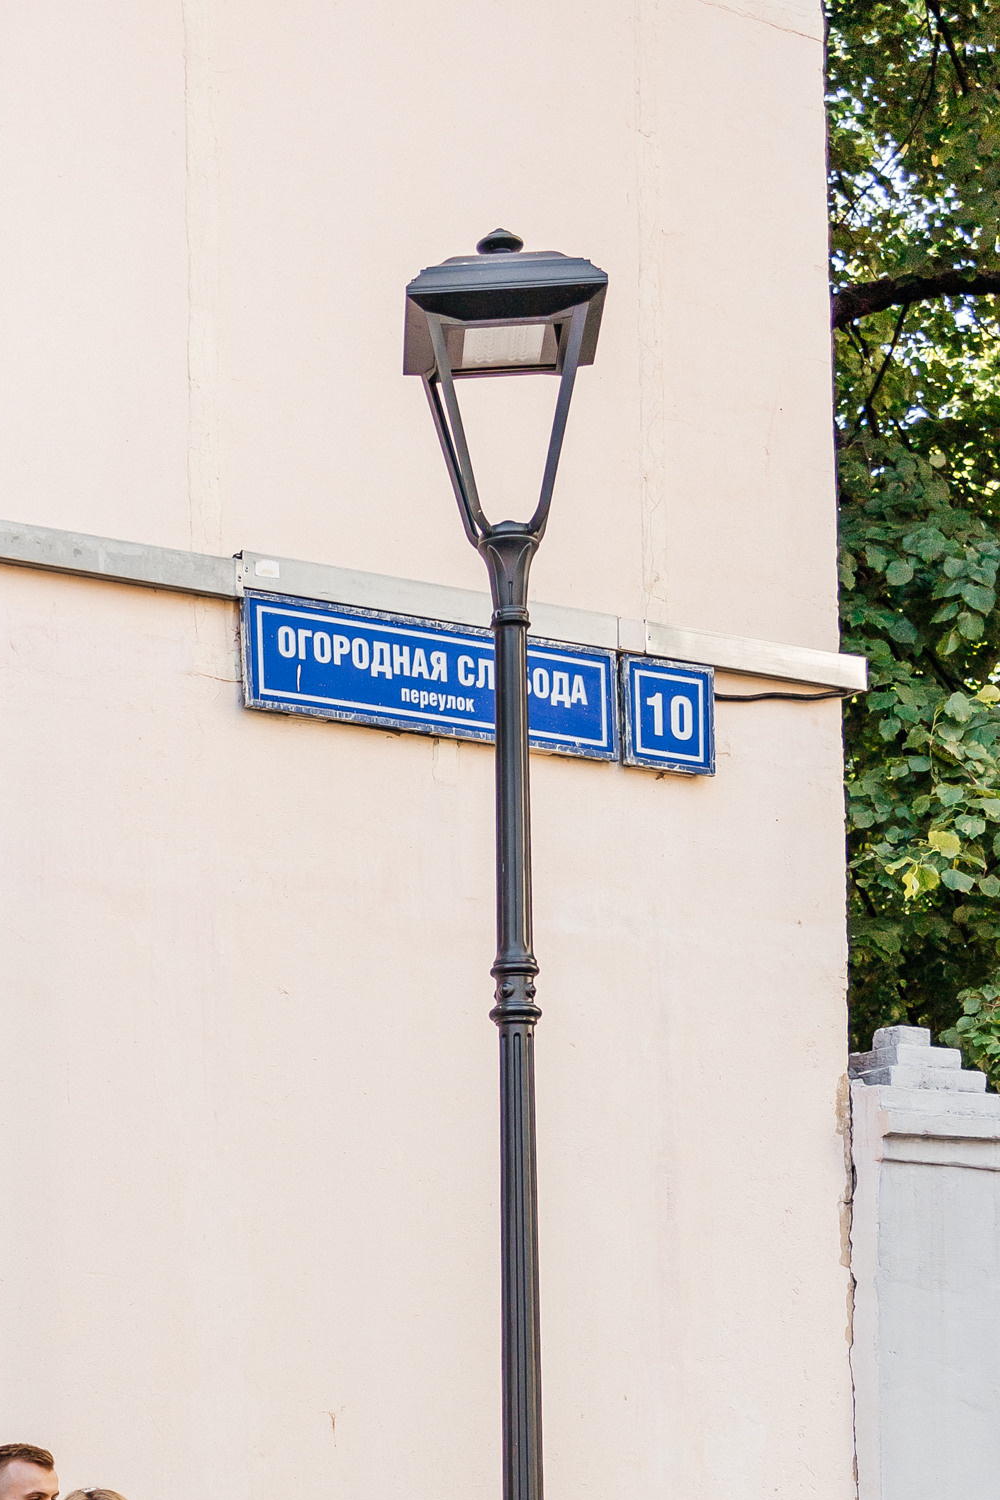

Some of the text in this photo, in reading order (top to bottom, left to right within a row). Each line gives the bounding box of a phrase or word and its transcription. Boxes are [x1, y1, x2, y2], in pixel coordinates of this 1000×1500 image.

[277, 625, 588, 709] ОГОРОДНАЯ СЛОДА
[401, 687, 475, 713] переулок
[646, 692, 694, 741] 10
